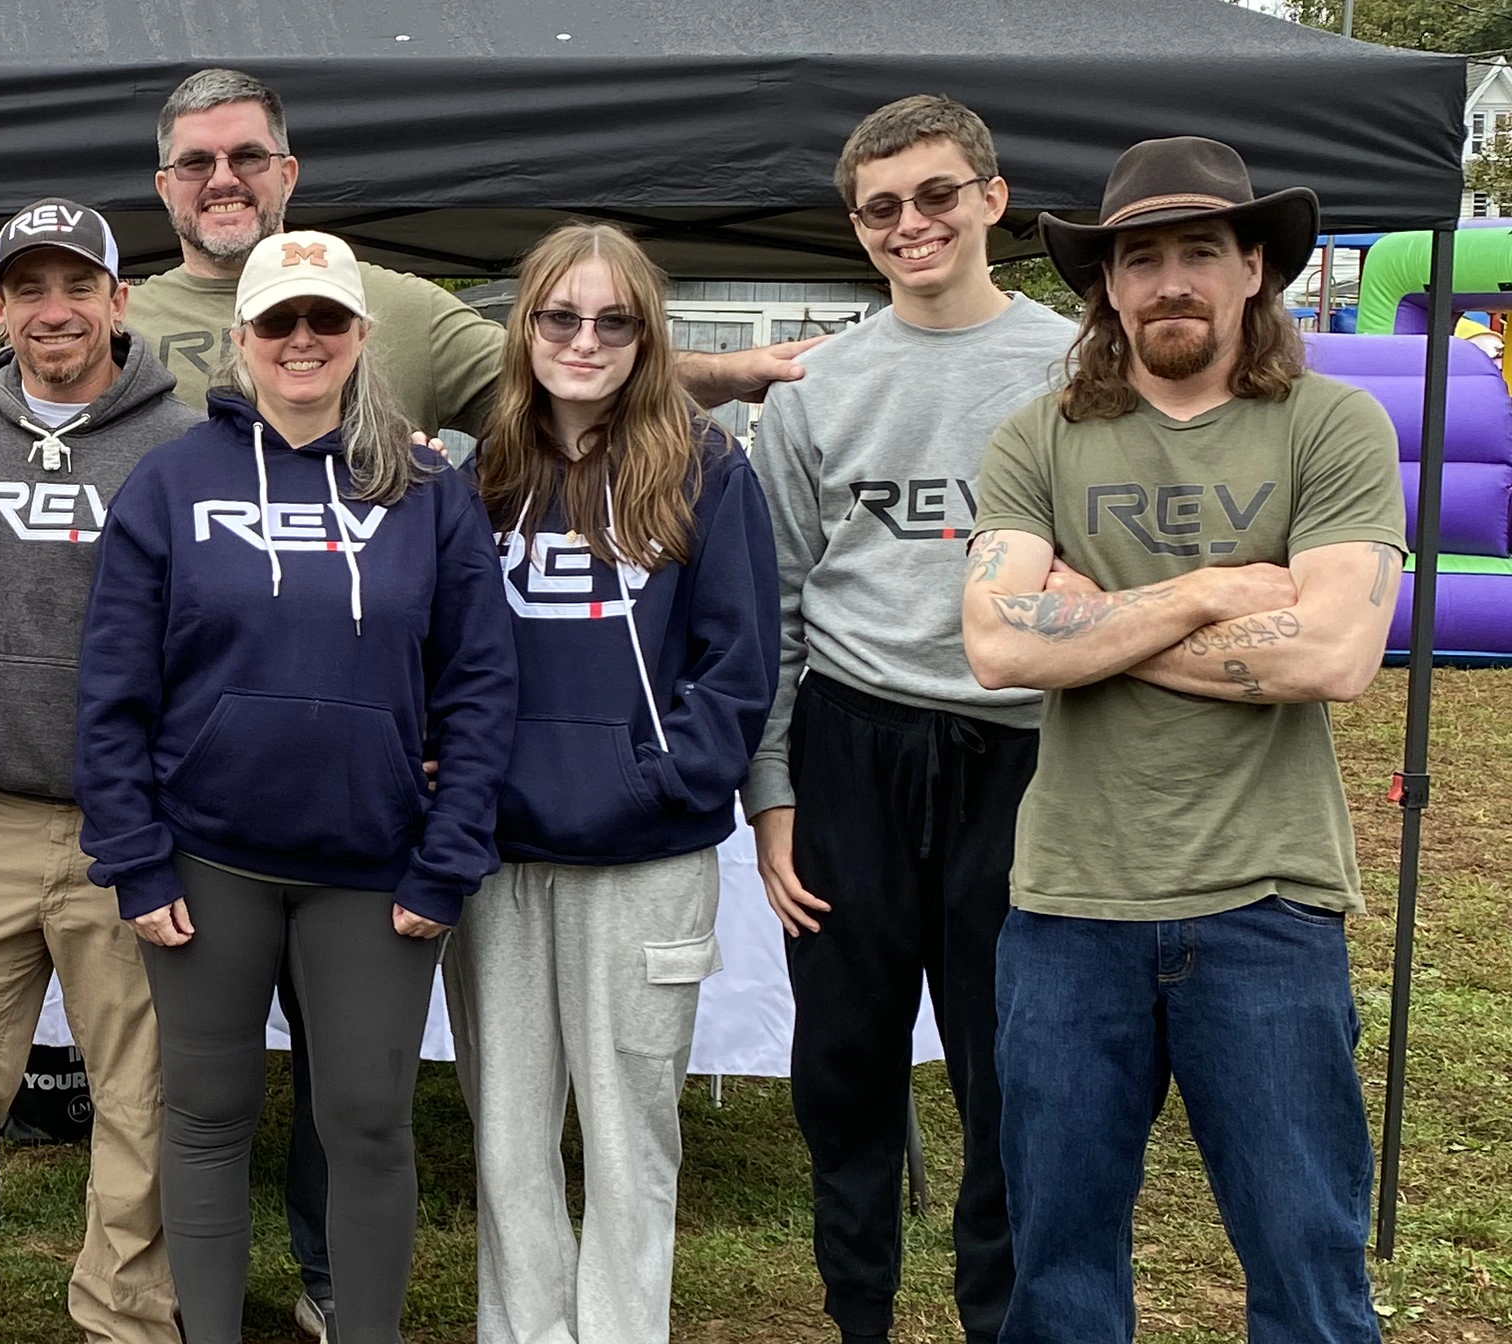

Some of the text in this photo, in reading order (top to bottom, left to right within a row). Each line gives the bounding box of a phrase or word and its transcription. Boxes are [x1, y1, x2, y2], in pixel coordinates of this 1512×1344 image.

[9, 204, 84, 241] REV
[281, 241, 328, 268] M
[193, 500, 388, 553] REV
[1086, 481, 1277, 556] REV
[23, 1071, 87, 1091] YOUR
